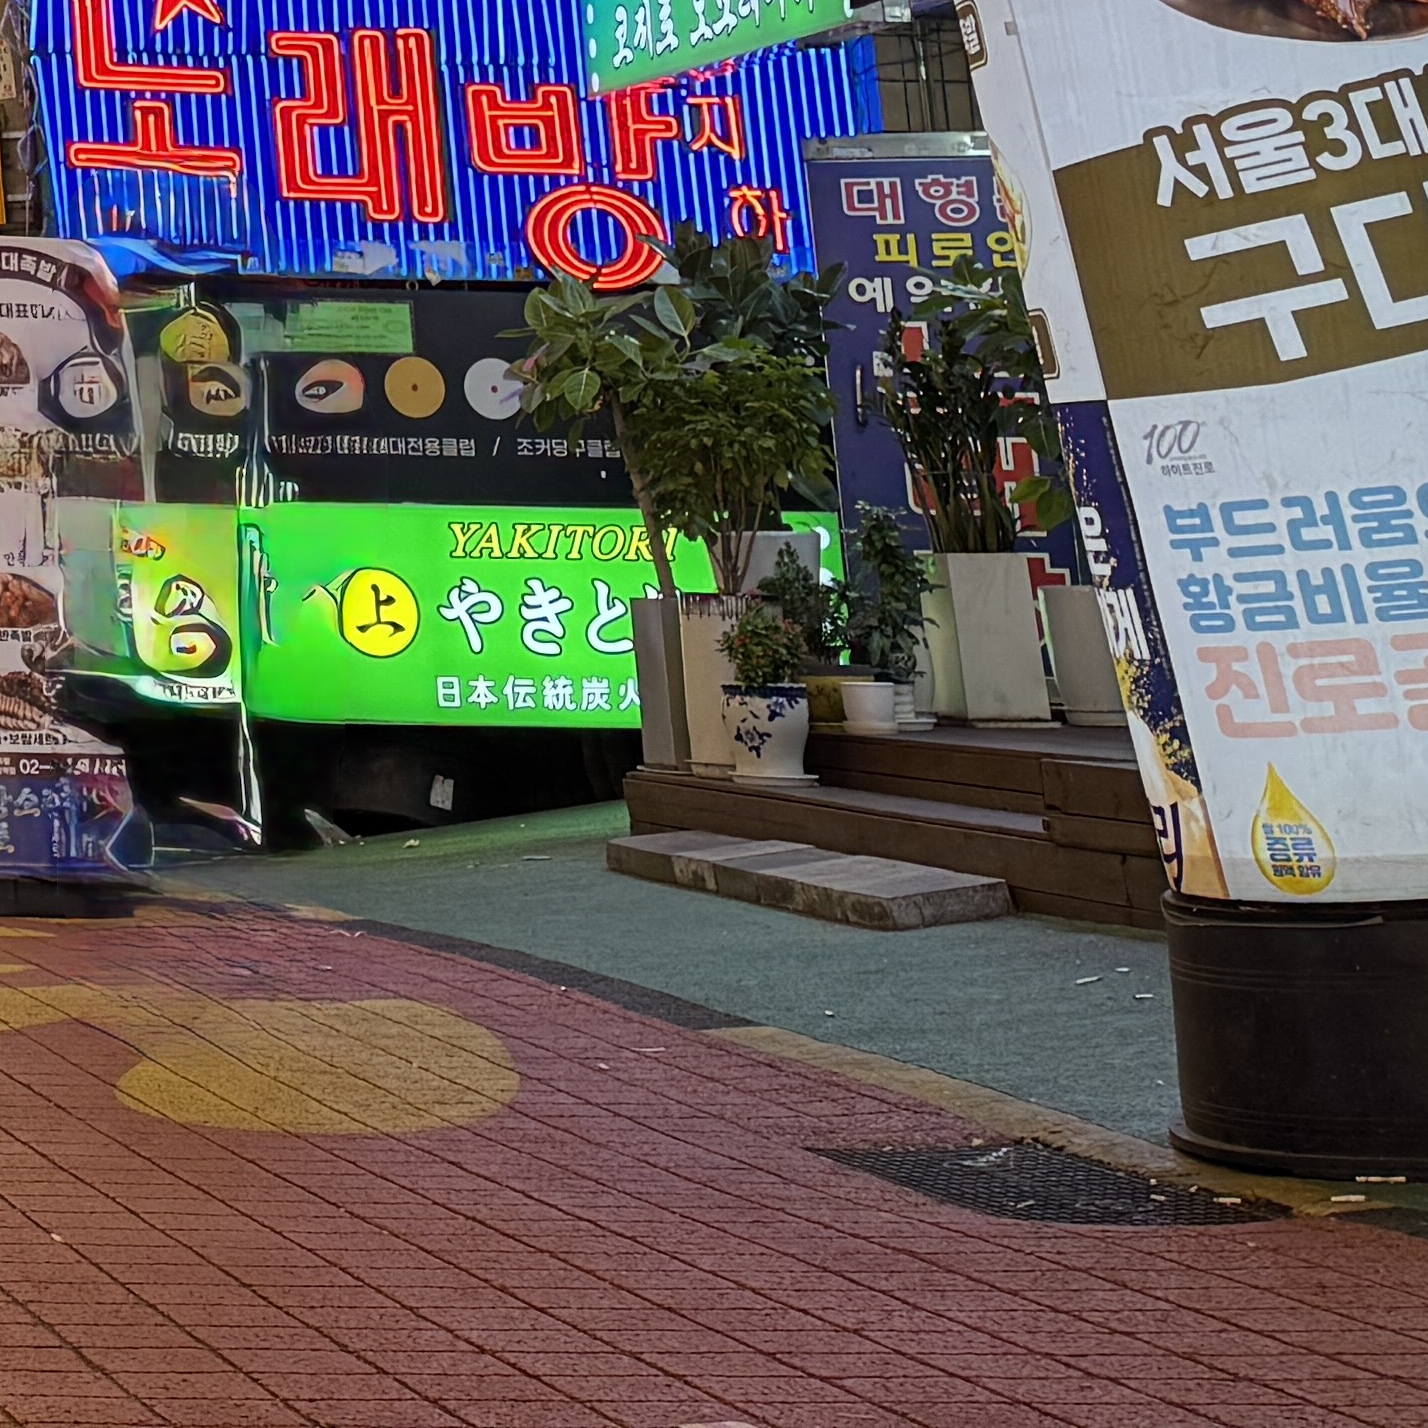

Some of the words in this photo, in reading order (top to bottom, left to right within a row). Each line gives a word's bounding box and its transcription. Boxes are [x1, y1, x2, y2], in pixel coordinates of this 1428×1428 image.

[842, 175, 1011, 227] 대형
[439, 575, 673, 657] やきと
